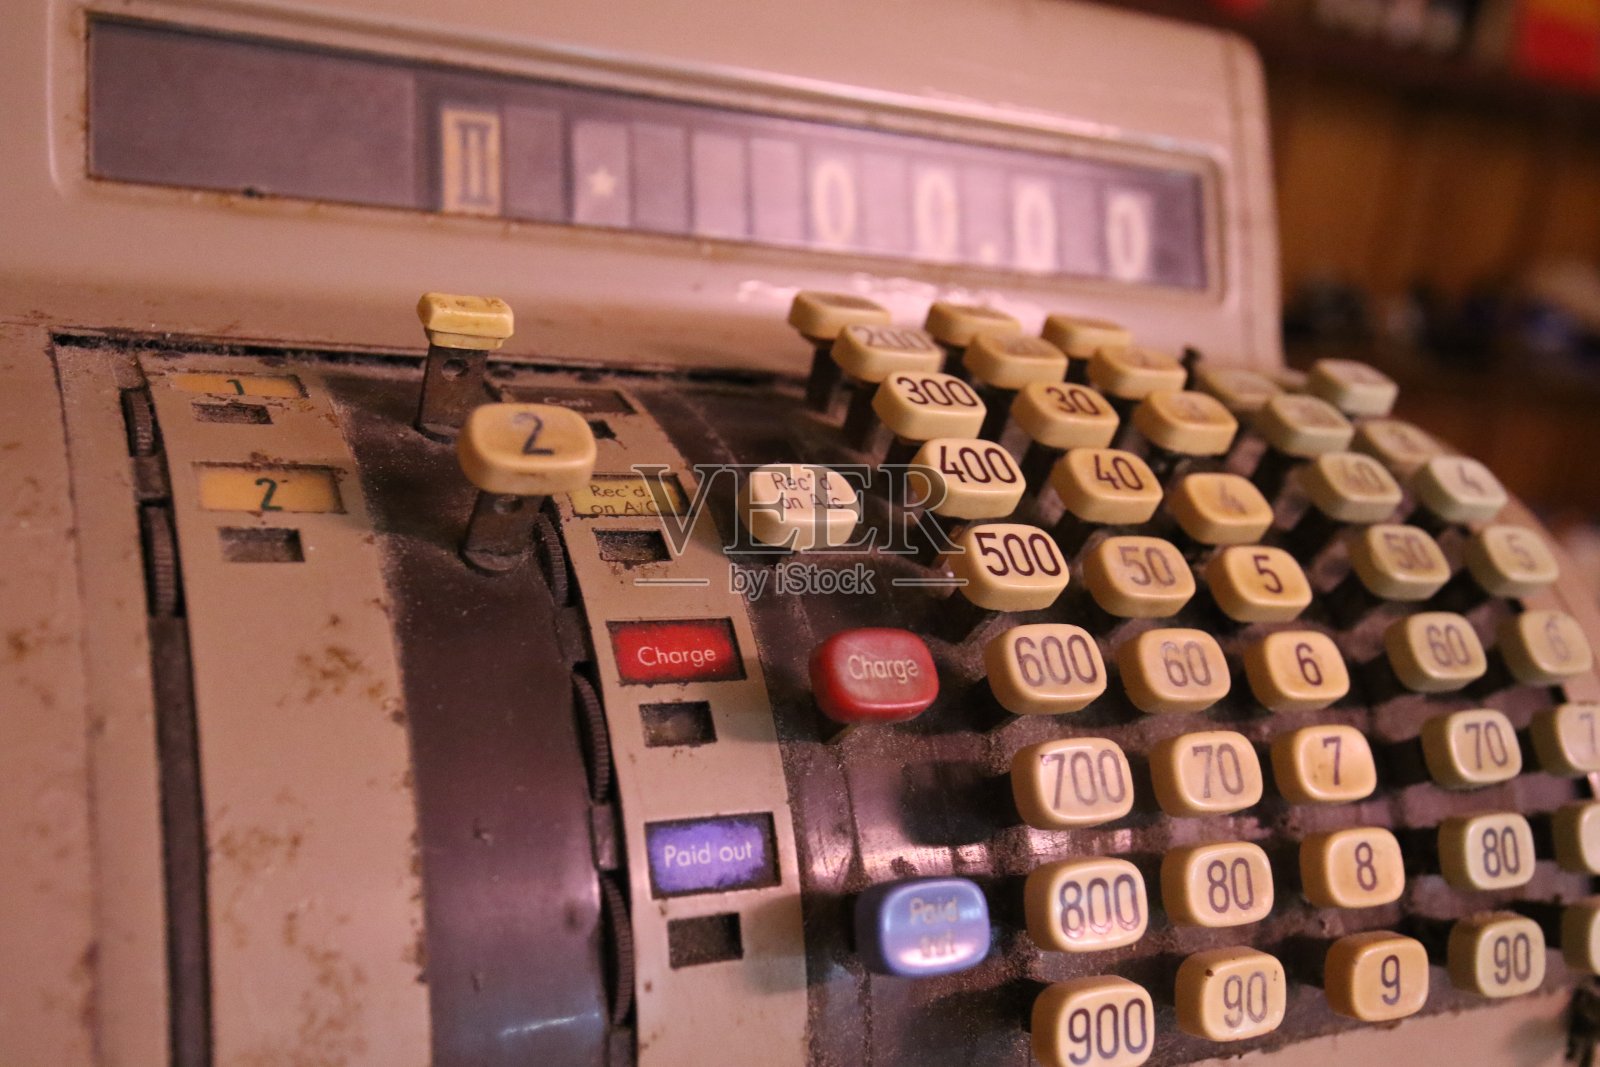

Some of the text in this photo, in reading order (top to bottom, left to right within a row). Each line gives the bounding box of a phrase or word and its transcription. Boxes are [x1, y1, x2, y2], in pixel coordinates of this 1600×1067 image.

[852, 326, 936, 351] 200
[896, 376, 978, 407] 300
[1046, 386, 1100, 416] 30
[512, 411, 556, 455] 2
[939, 445, 1017, 484] 400
[1094, 454, 1144, 492] 40
[255, 478, 283, 511] 2
[591, 503, 616, 515] on
[780, 497, 804, 510] on
[973, 531, 1062, 577] 500
[1118, 545, 1177, 588] 50
[1252, 554, 1284, 594] 5
[1383, 532, 1435, 571] 50
[637, 645, 717, 668] Charge
[1015, 634, 1098, 688] 600
[1160, 640, 1213, 687] 60
[1295, 642, 1324, 687] 6
[1425, 622, 1471, 668] 60
[847, 654, 920, 684] Charge
[1322, 735, 1342, 786] 7
[1464, 720, 1509, 771] 70
[1041, 749, 1126, 810] 700
[1192, 743, 1244, 799] 70
[664, 840, 752, 868] Paid out
[1354, 841, 1378, 891] 8
[1481, 824, 1521, 878] 80
[1059, 873, 1142, 940] 800
[1206, 857, 1255, 914] 80
[909, 896, 960, 925] Paid
[1380, 954, 1401, 1006] 9
[1493, 931, 1532, 985] 90
[1222, 970, 1269, 1029] 90
[1068, 997, 1148, 1066] 900
